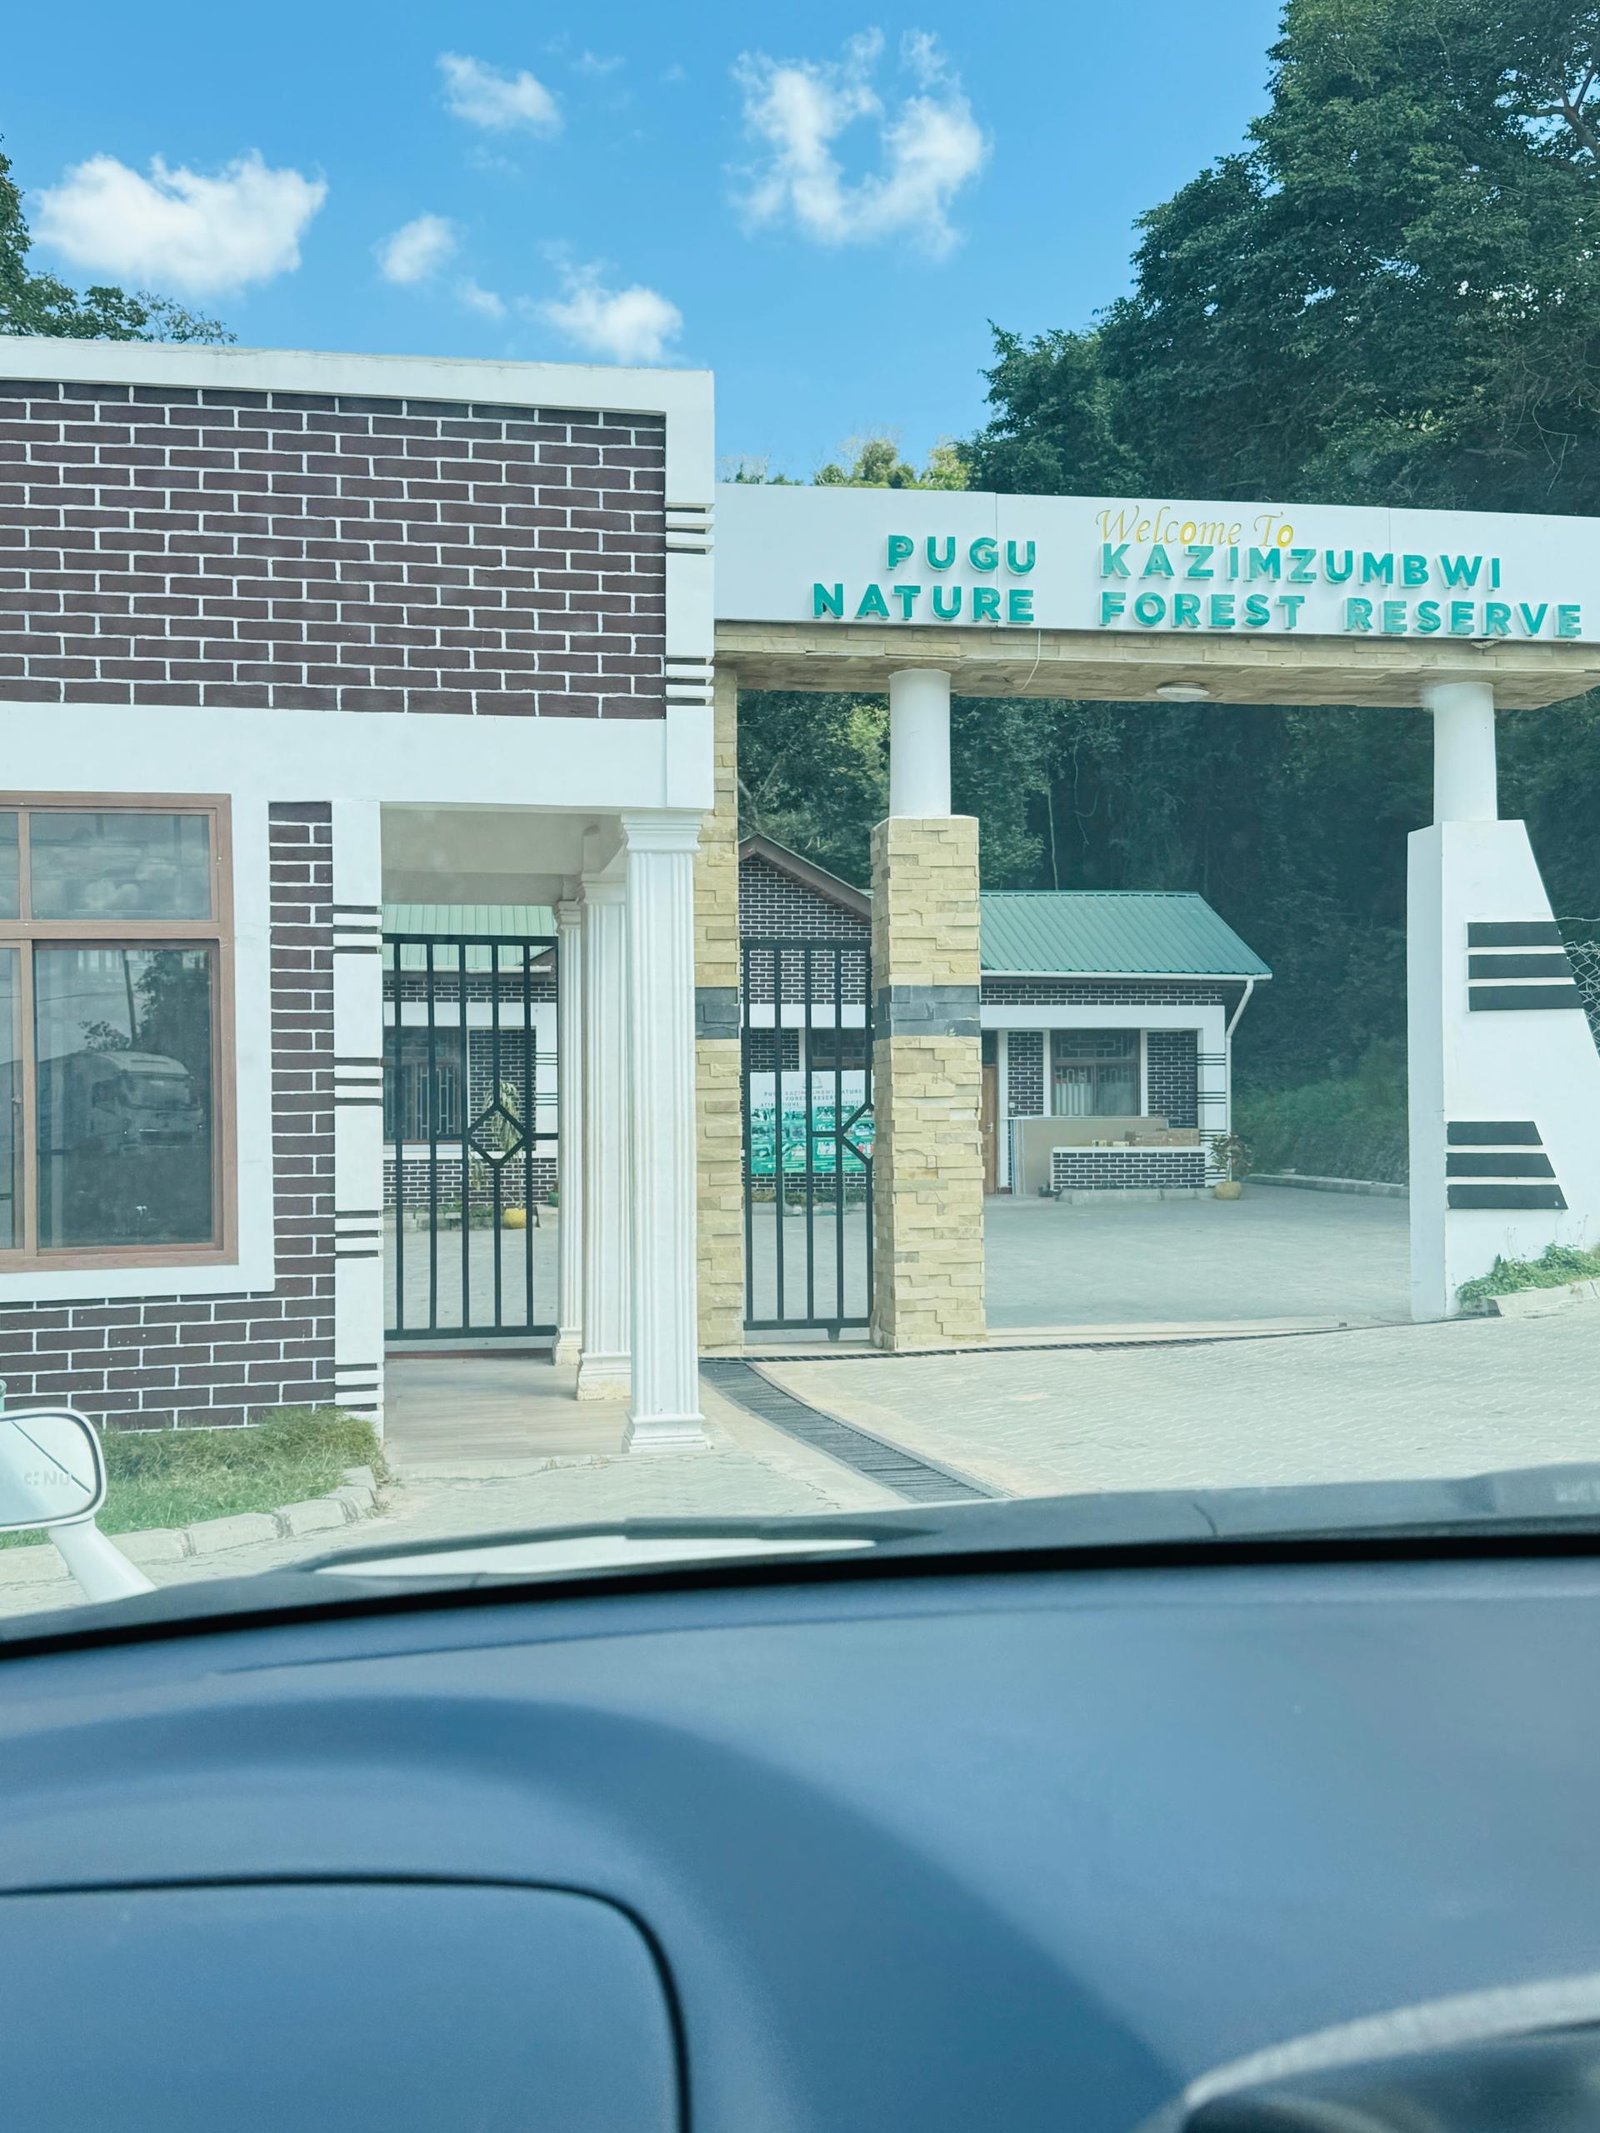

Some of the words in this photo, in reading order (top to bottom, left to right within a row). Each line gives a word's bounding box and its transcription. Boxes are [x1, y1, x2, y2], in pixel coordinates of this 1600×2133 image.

[1096, 505, 1242, 545] Welcome
[1253, 510, 1294, 548] To
[887, 534, 1036, 576] PUGU
[1099, 543, 1501, 591] KAZIMZUMBWI
[812, 583, 1035, 624] NATURE
[1099, 591, 1305, 630] FOREST
[1343, 597, 1582, 639] RESERVE
